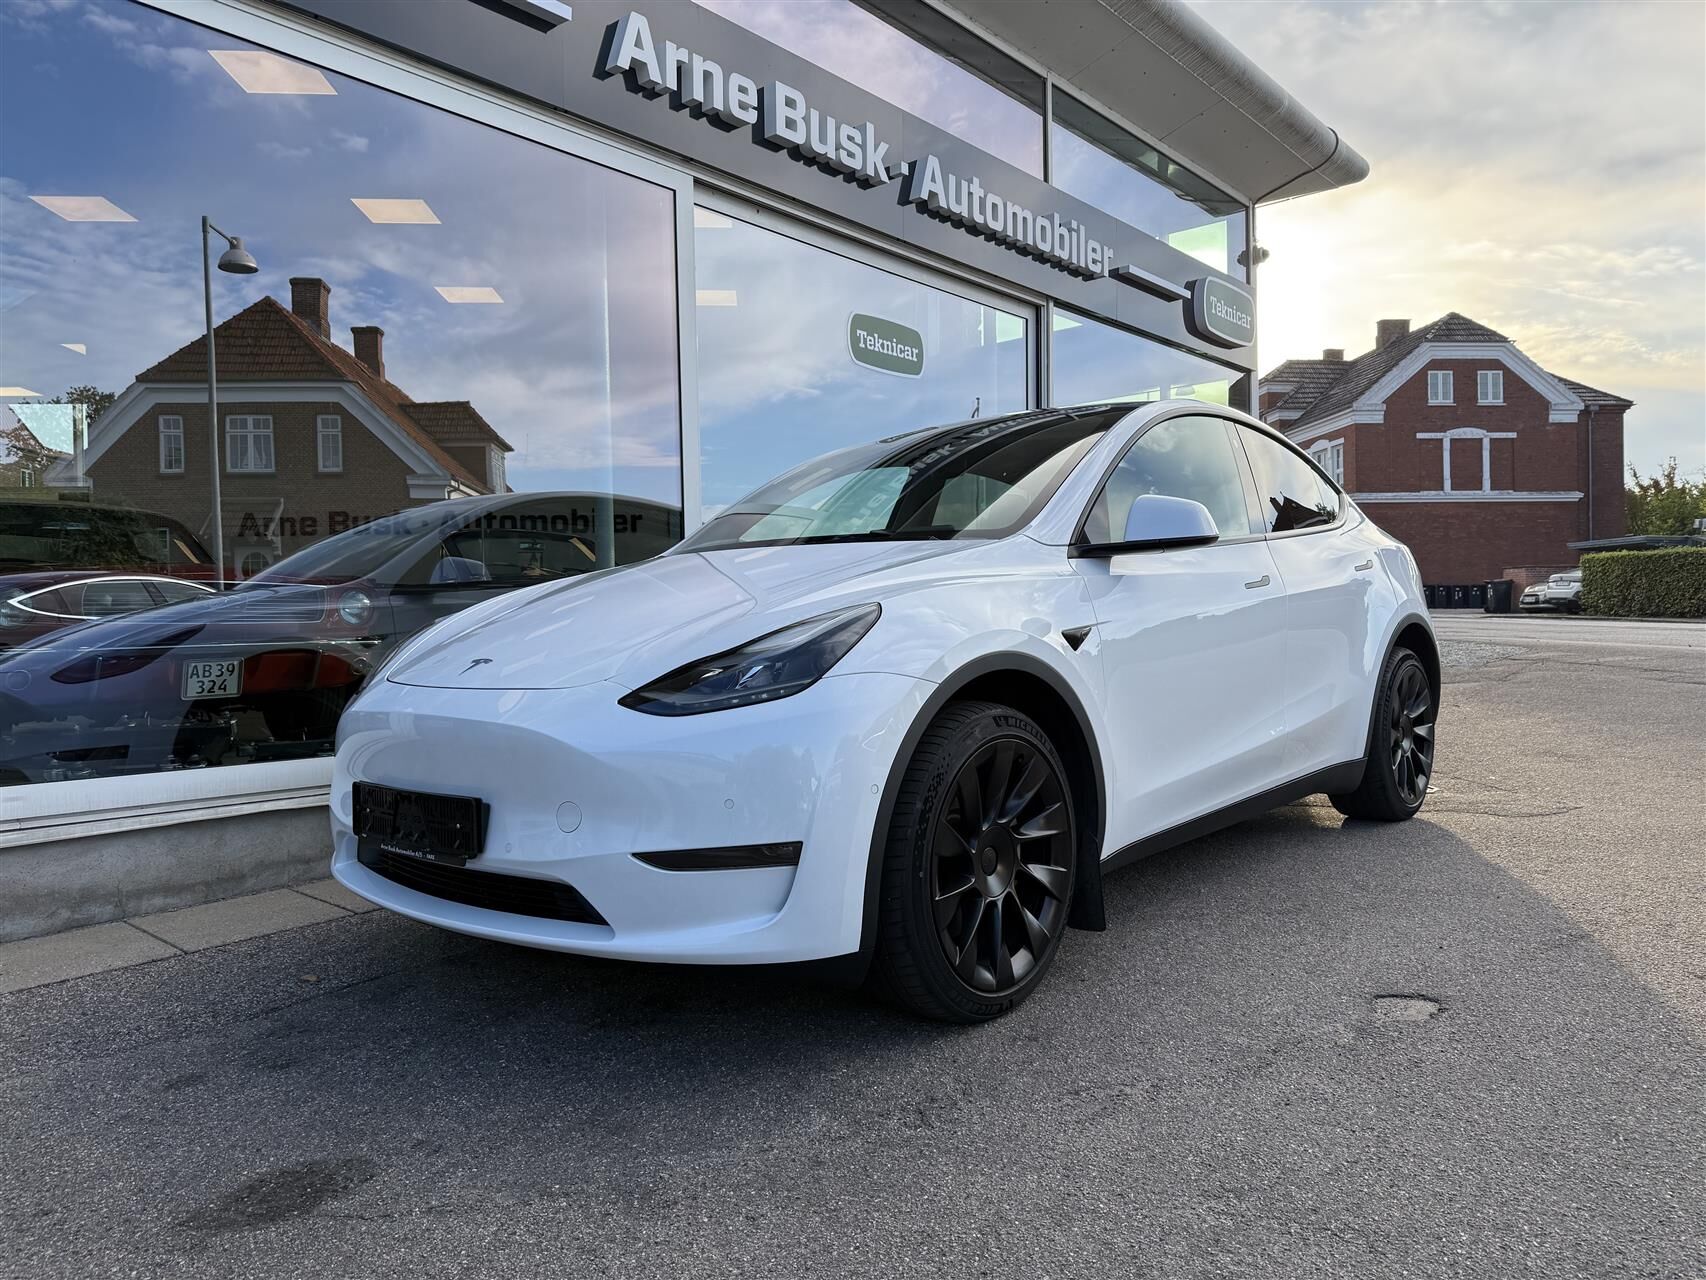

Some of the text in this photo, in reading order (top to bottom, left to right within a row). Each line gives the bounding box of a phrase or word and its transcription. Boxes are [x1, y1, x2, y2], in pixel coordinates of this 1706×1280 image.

[610, 10, 758, 125] Arne
[770, 80, 890, 184] Busk
[915, 153, 1114, 278] Automobiler
[1209, 295, 1252, 329] Teknicar
[856, 328, 919, 362] Teknicar
[189, 662, 236, 680] AB39
[195, 678, 228, 695] 324
